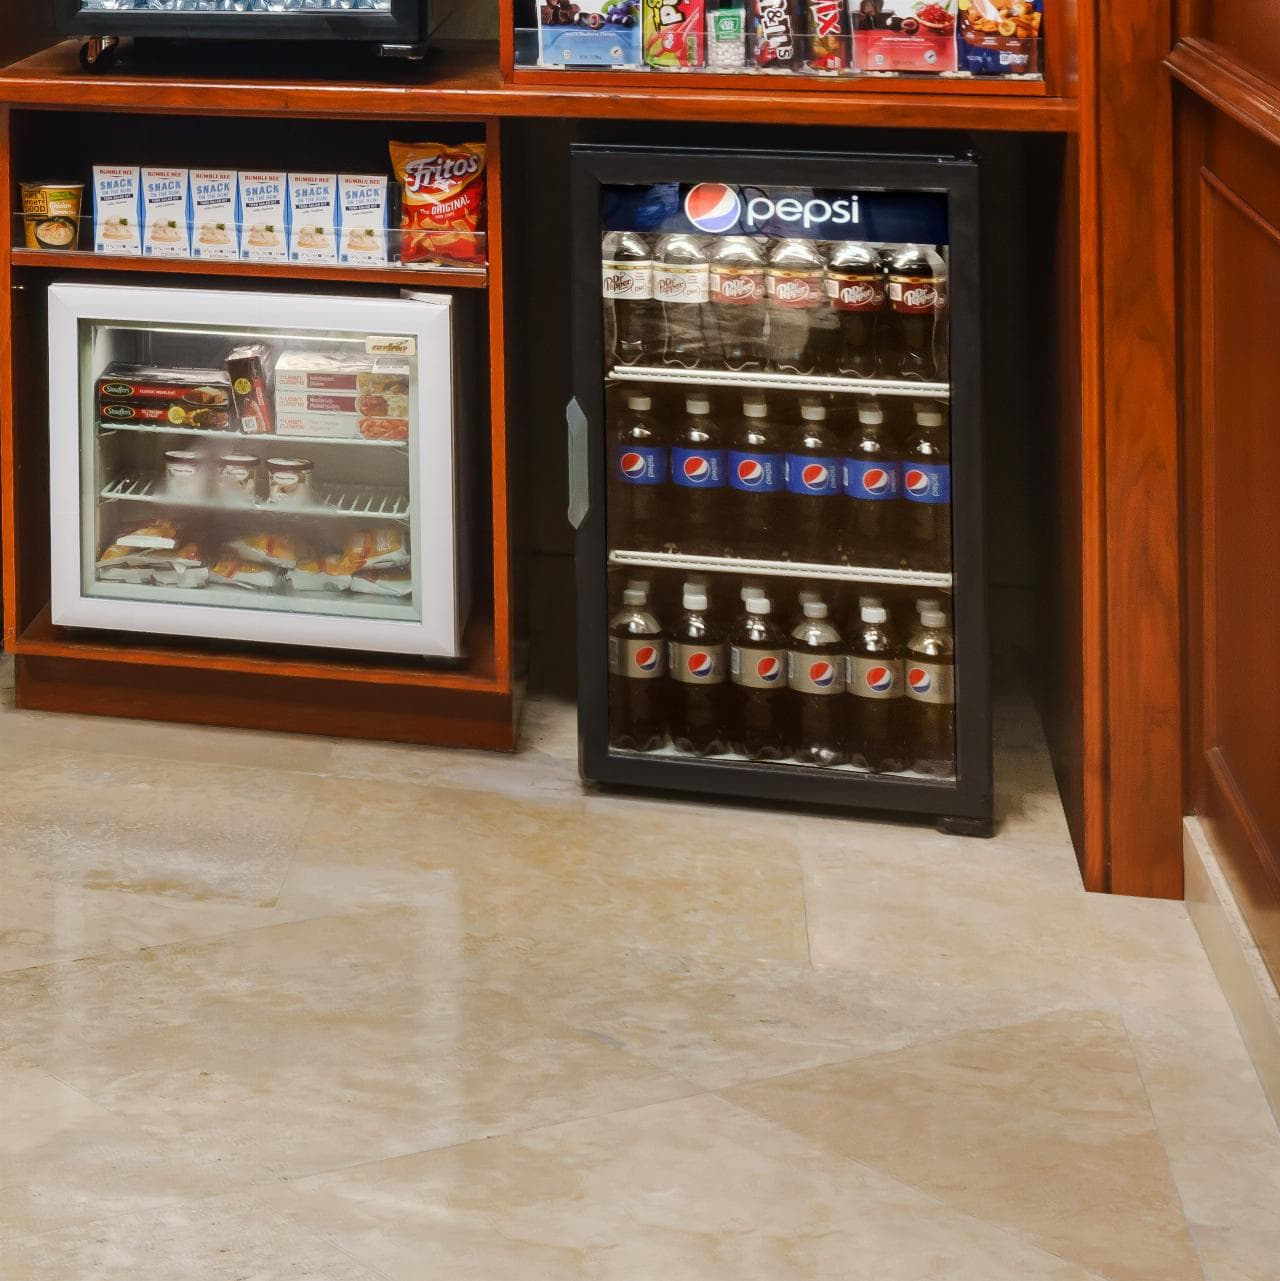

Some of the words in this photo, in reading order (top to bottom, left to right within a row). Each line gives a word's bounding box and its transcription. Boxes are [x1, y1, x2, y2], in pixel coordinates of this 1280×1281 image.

[405, 154, 479, 192] Fritos
[101, 179, 132, 189] SNACK
[148, 181, 181, 192] SNACK
[197, 183, 230, 194] SNACK
[245, 185, 279, 196] SNACK
[295, 186, 329, 198] SNACK
[345, 188, 379, 200] SNACK
[431, 195, 470, 215] ORIGINAL
[746, 195, 859, 227] pepsi
[613, 273, 623, 283] Dr
[603, 278, 631, 291] Pepper
[851, 285, 865, 294] Dr
[915, 288, 928, 297] Dr
[646, 455, 655, 478] pepsi
[930, 473, 940, 497] pepsi
